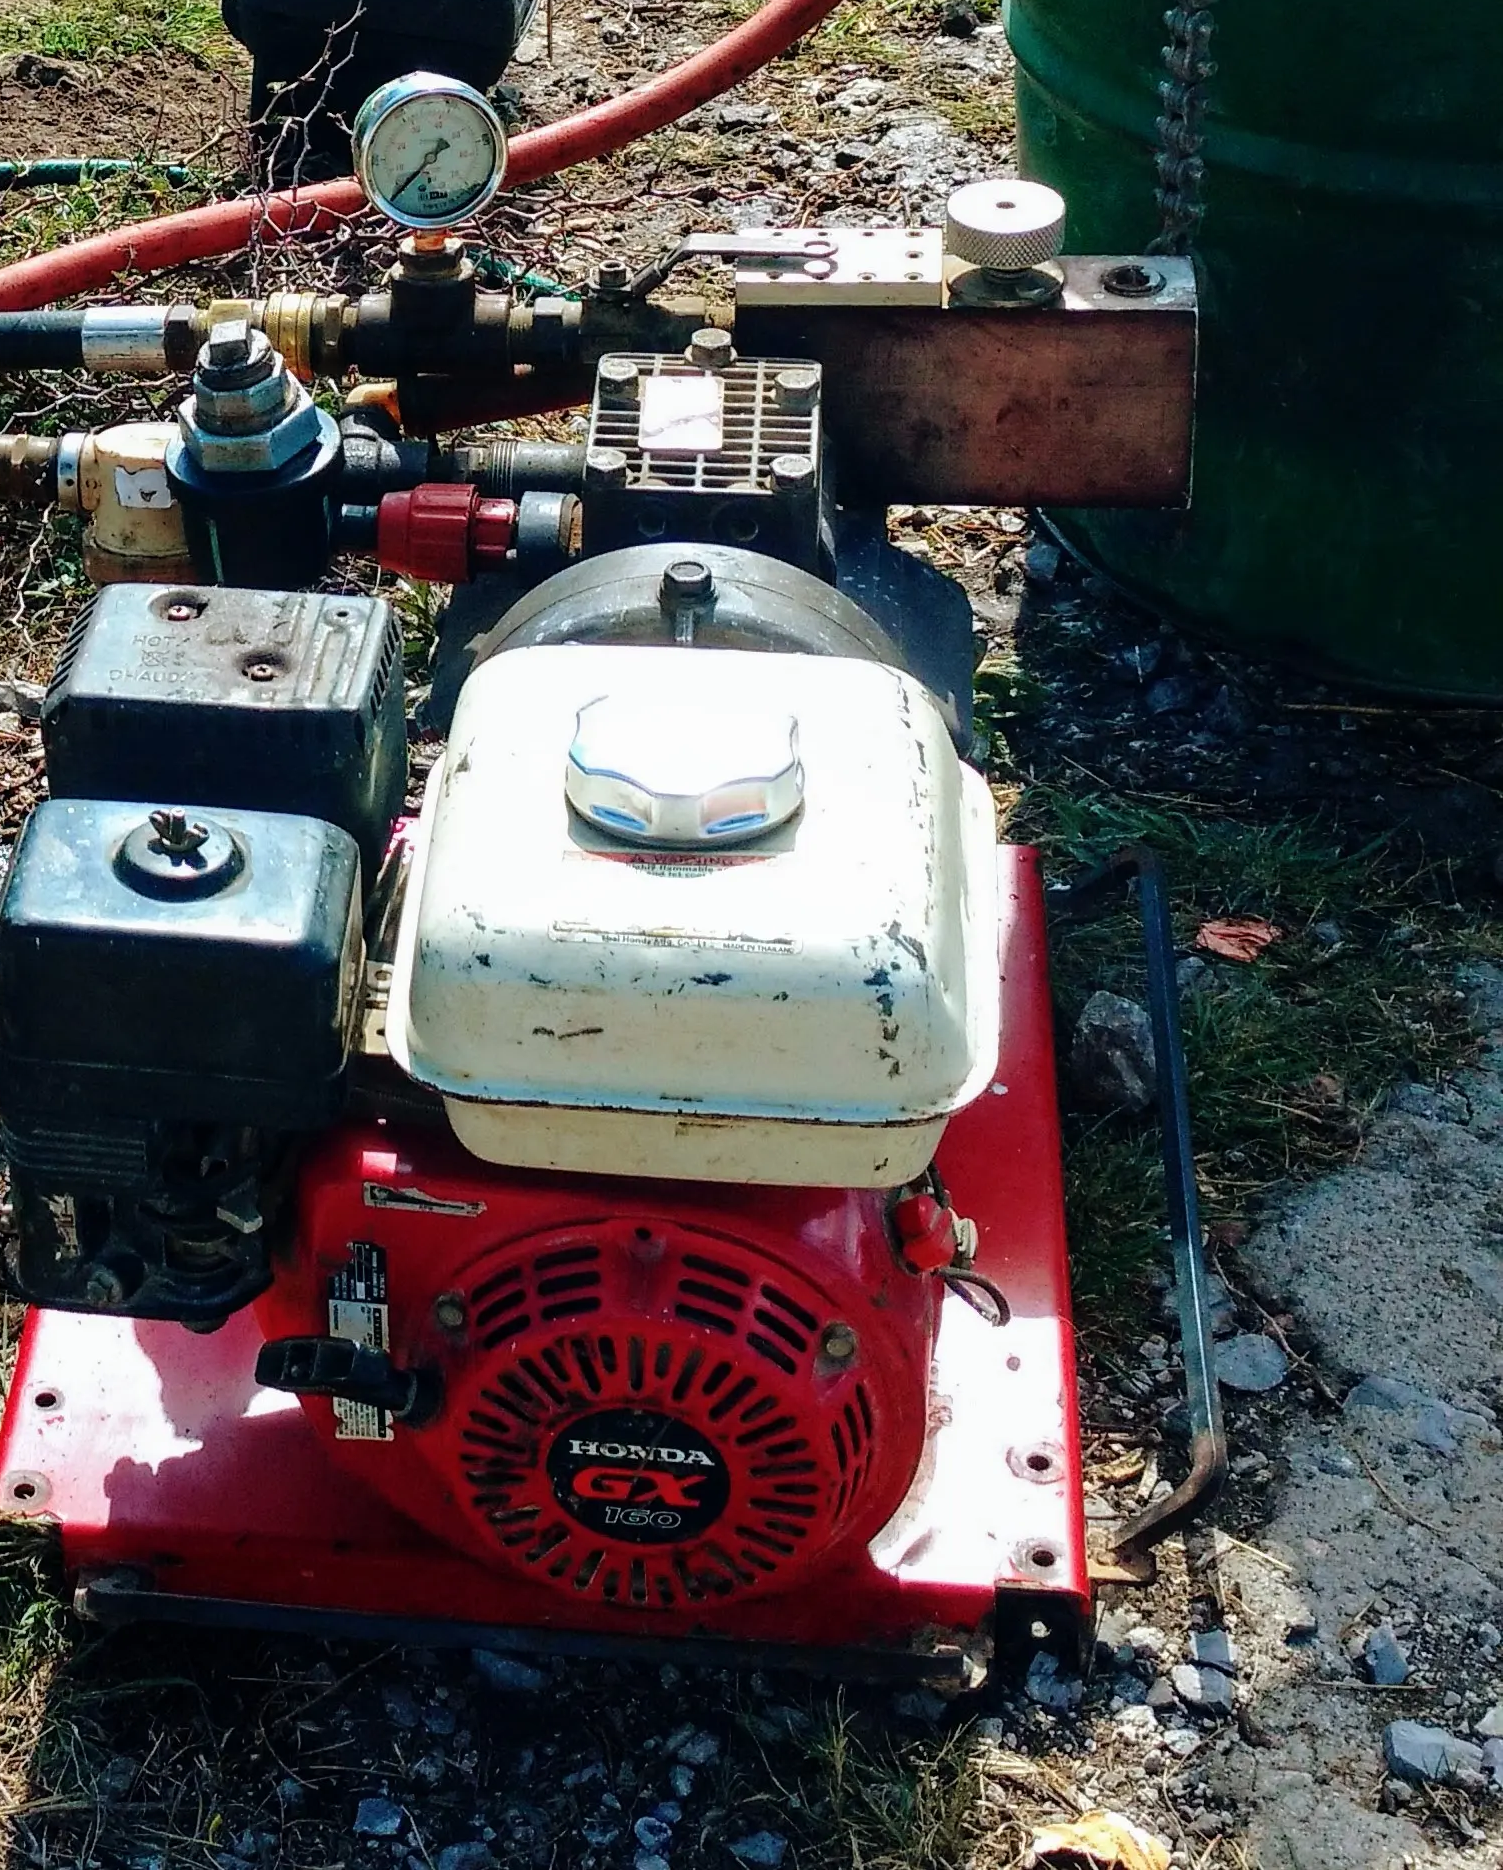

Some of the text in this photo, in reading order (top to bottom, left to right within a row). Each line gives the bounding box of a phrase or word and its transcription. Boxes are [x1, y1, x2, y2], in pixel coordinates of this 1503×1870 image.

[722, 942, 744, 950] MADE
[569, 1439, 715, 1466] HONDA
[572, 1467, 707, 1508] GX
[605, 1506, 681, 1528] 160
